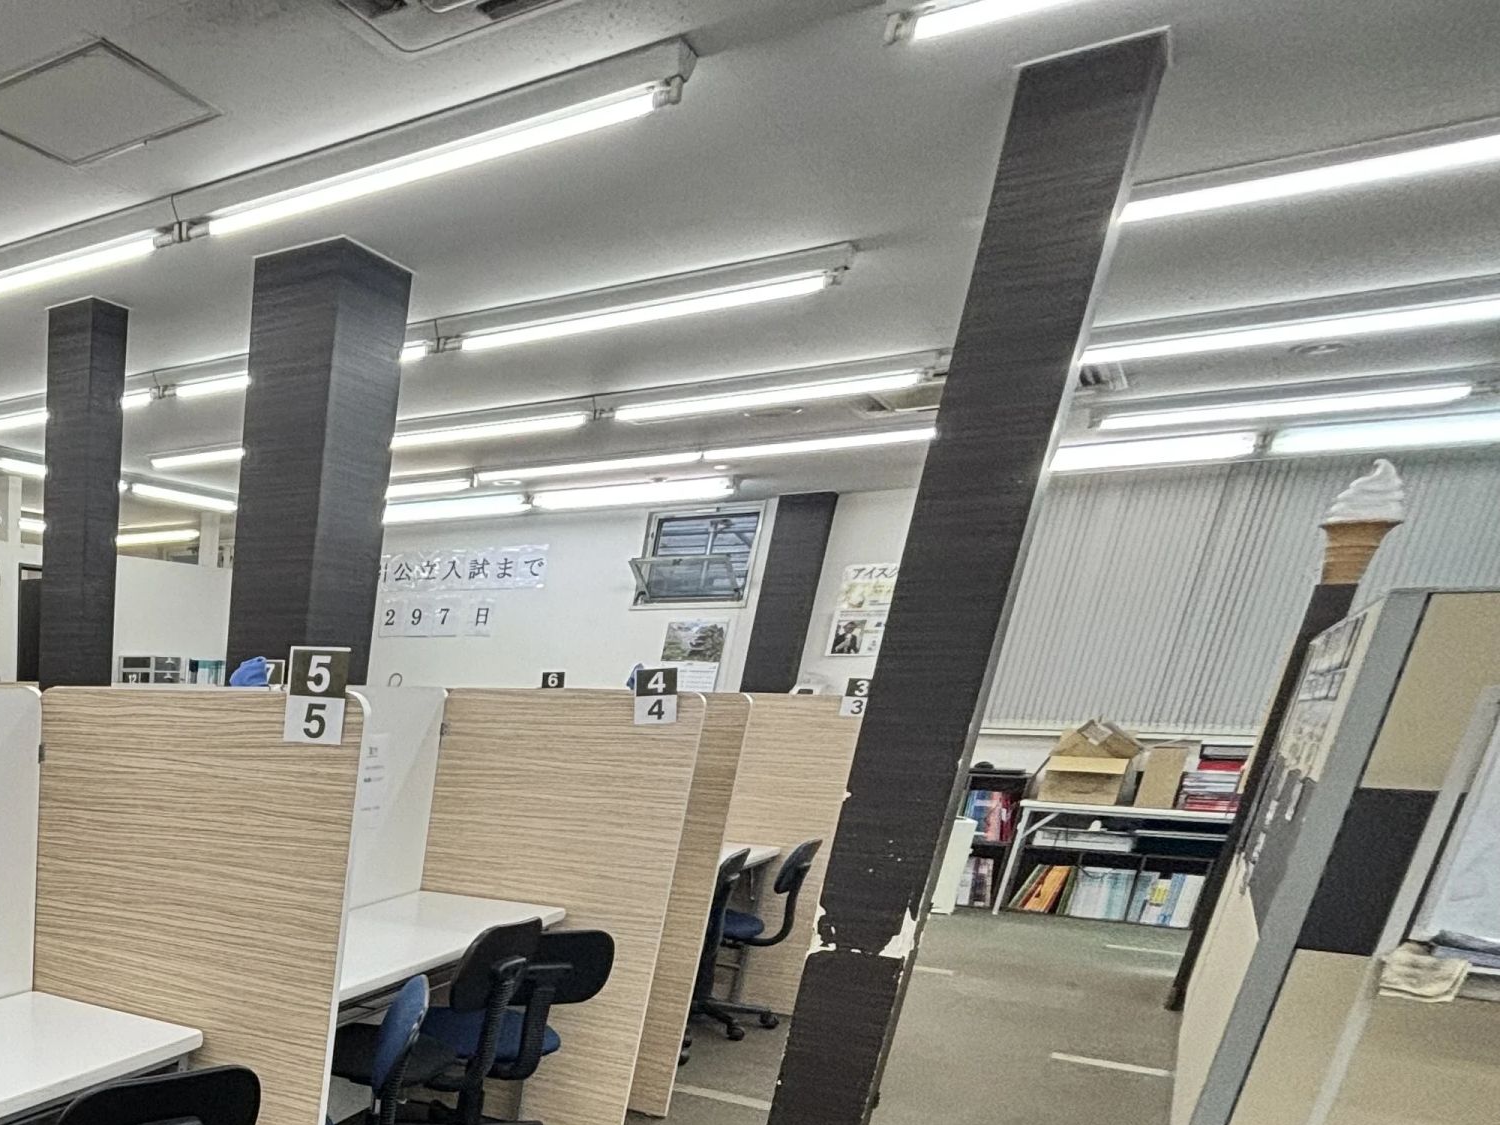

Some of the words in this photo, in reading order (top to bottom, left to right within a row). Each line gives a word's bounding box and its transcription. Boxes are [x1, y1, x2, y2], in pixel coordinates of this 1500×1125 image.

[306, 654, 332, 693] 5
[547, 673, 559, 687] 6
[647, 671, 666, 693] 4
[854, 680, 870, 696] 3
[647, 699, 665, 720] 4
[850, 699, 863, 715] 3
[303, 703, 327, 738] 5
